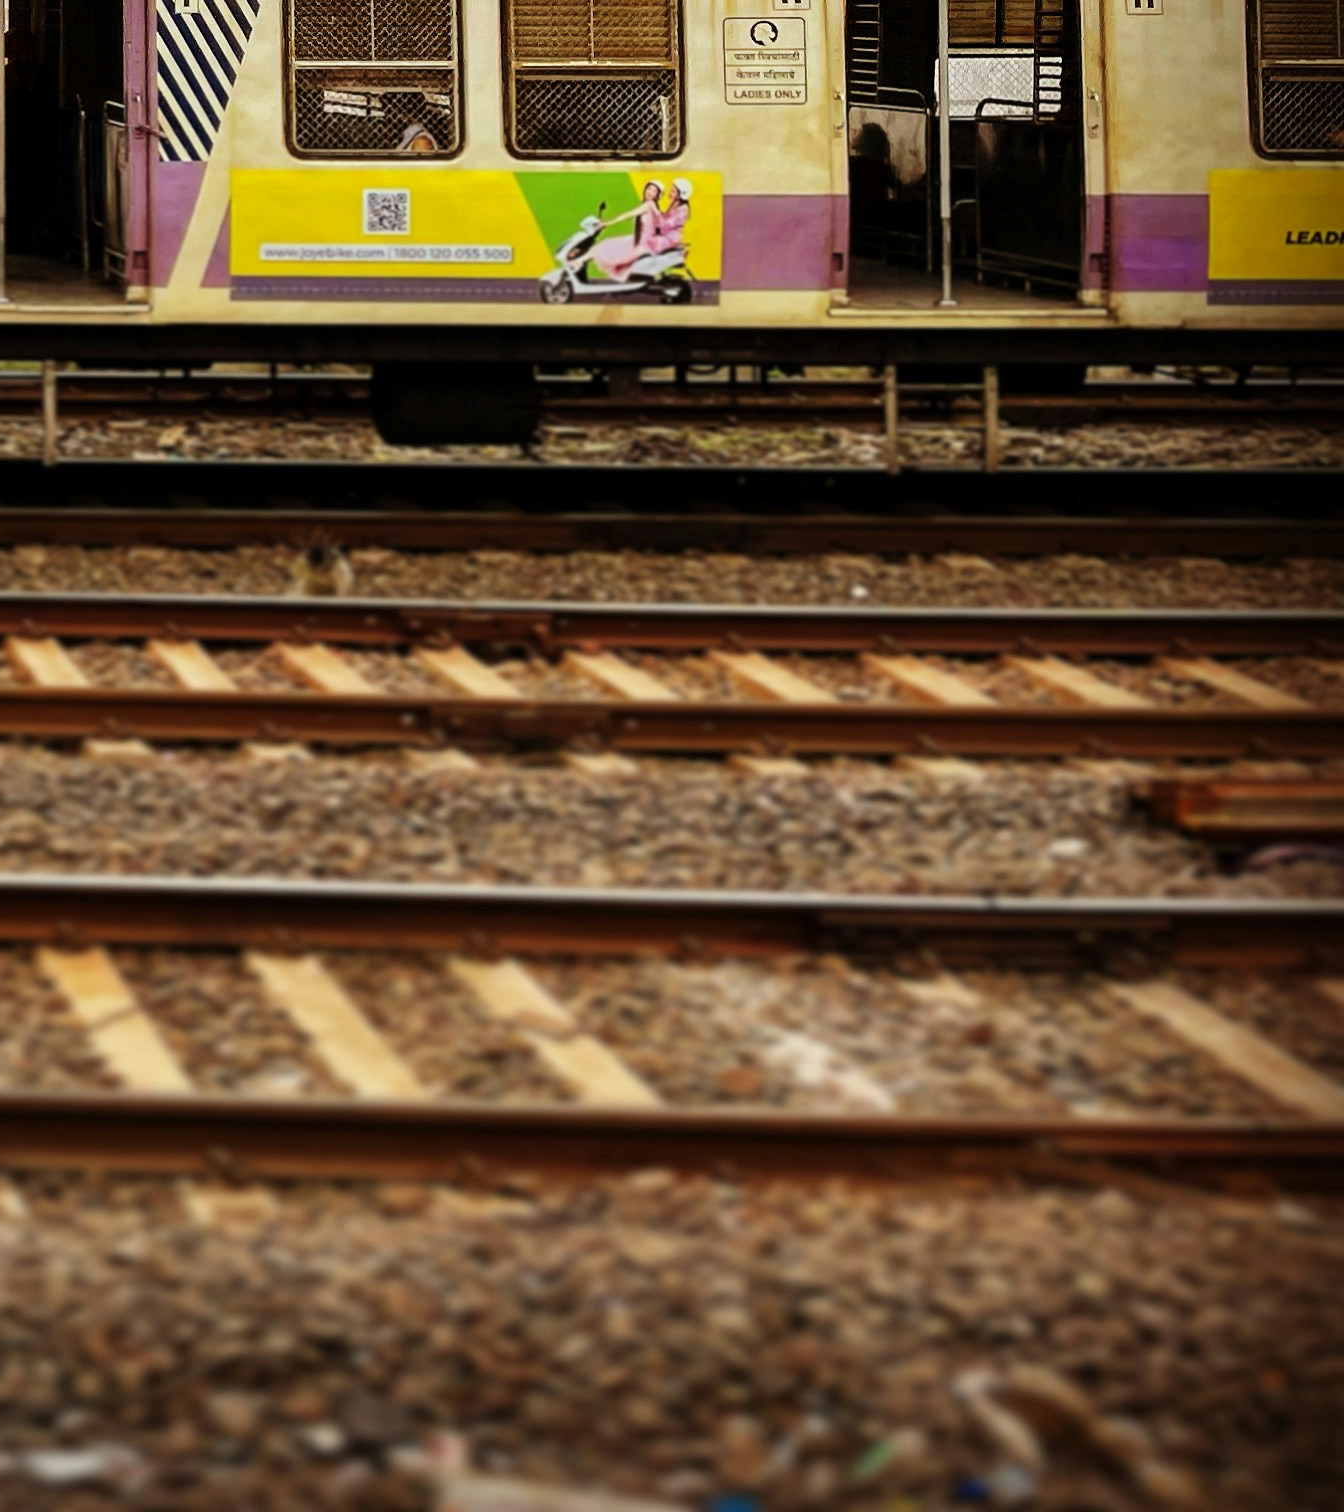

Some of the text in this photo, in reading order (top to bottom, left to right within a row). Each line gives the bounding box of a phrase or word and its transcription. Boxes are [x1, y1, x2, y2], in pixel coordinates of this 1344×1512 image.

[733, 90, 802, 99] LADIES ONLY
[263, 246, 386, 260] www.joyebike.com
[393, 247, 427, 259] 1800
[429, 247, 452, 259] 120
[483, 247, 511, 259] 500
